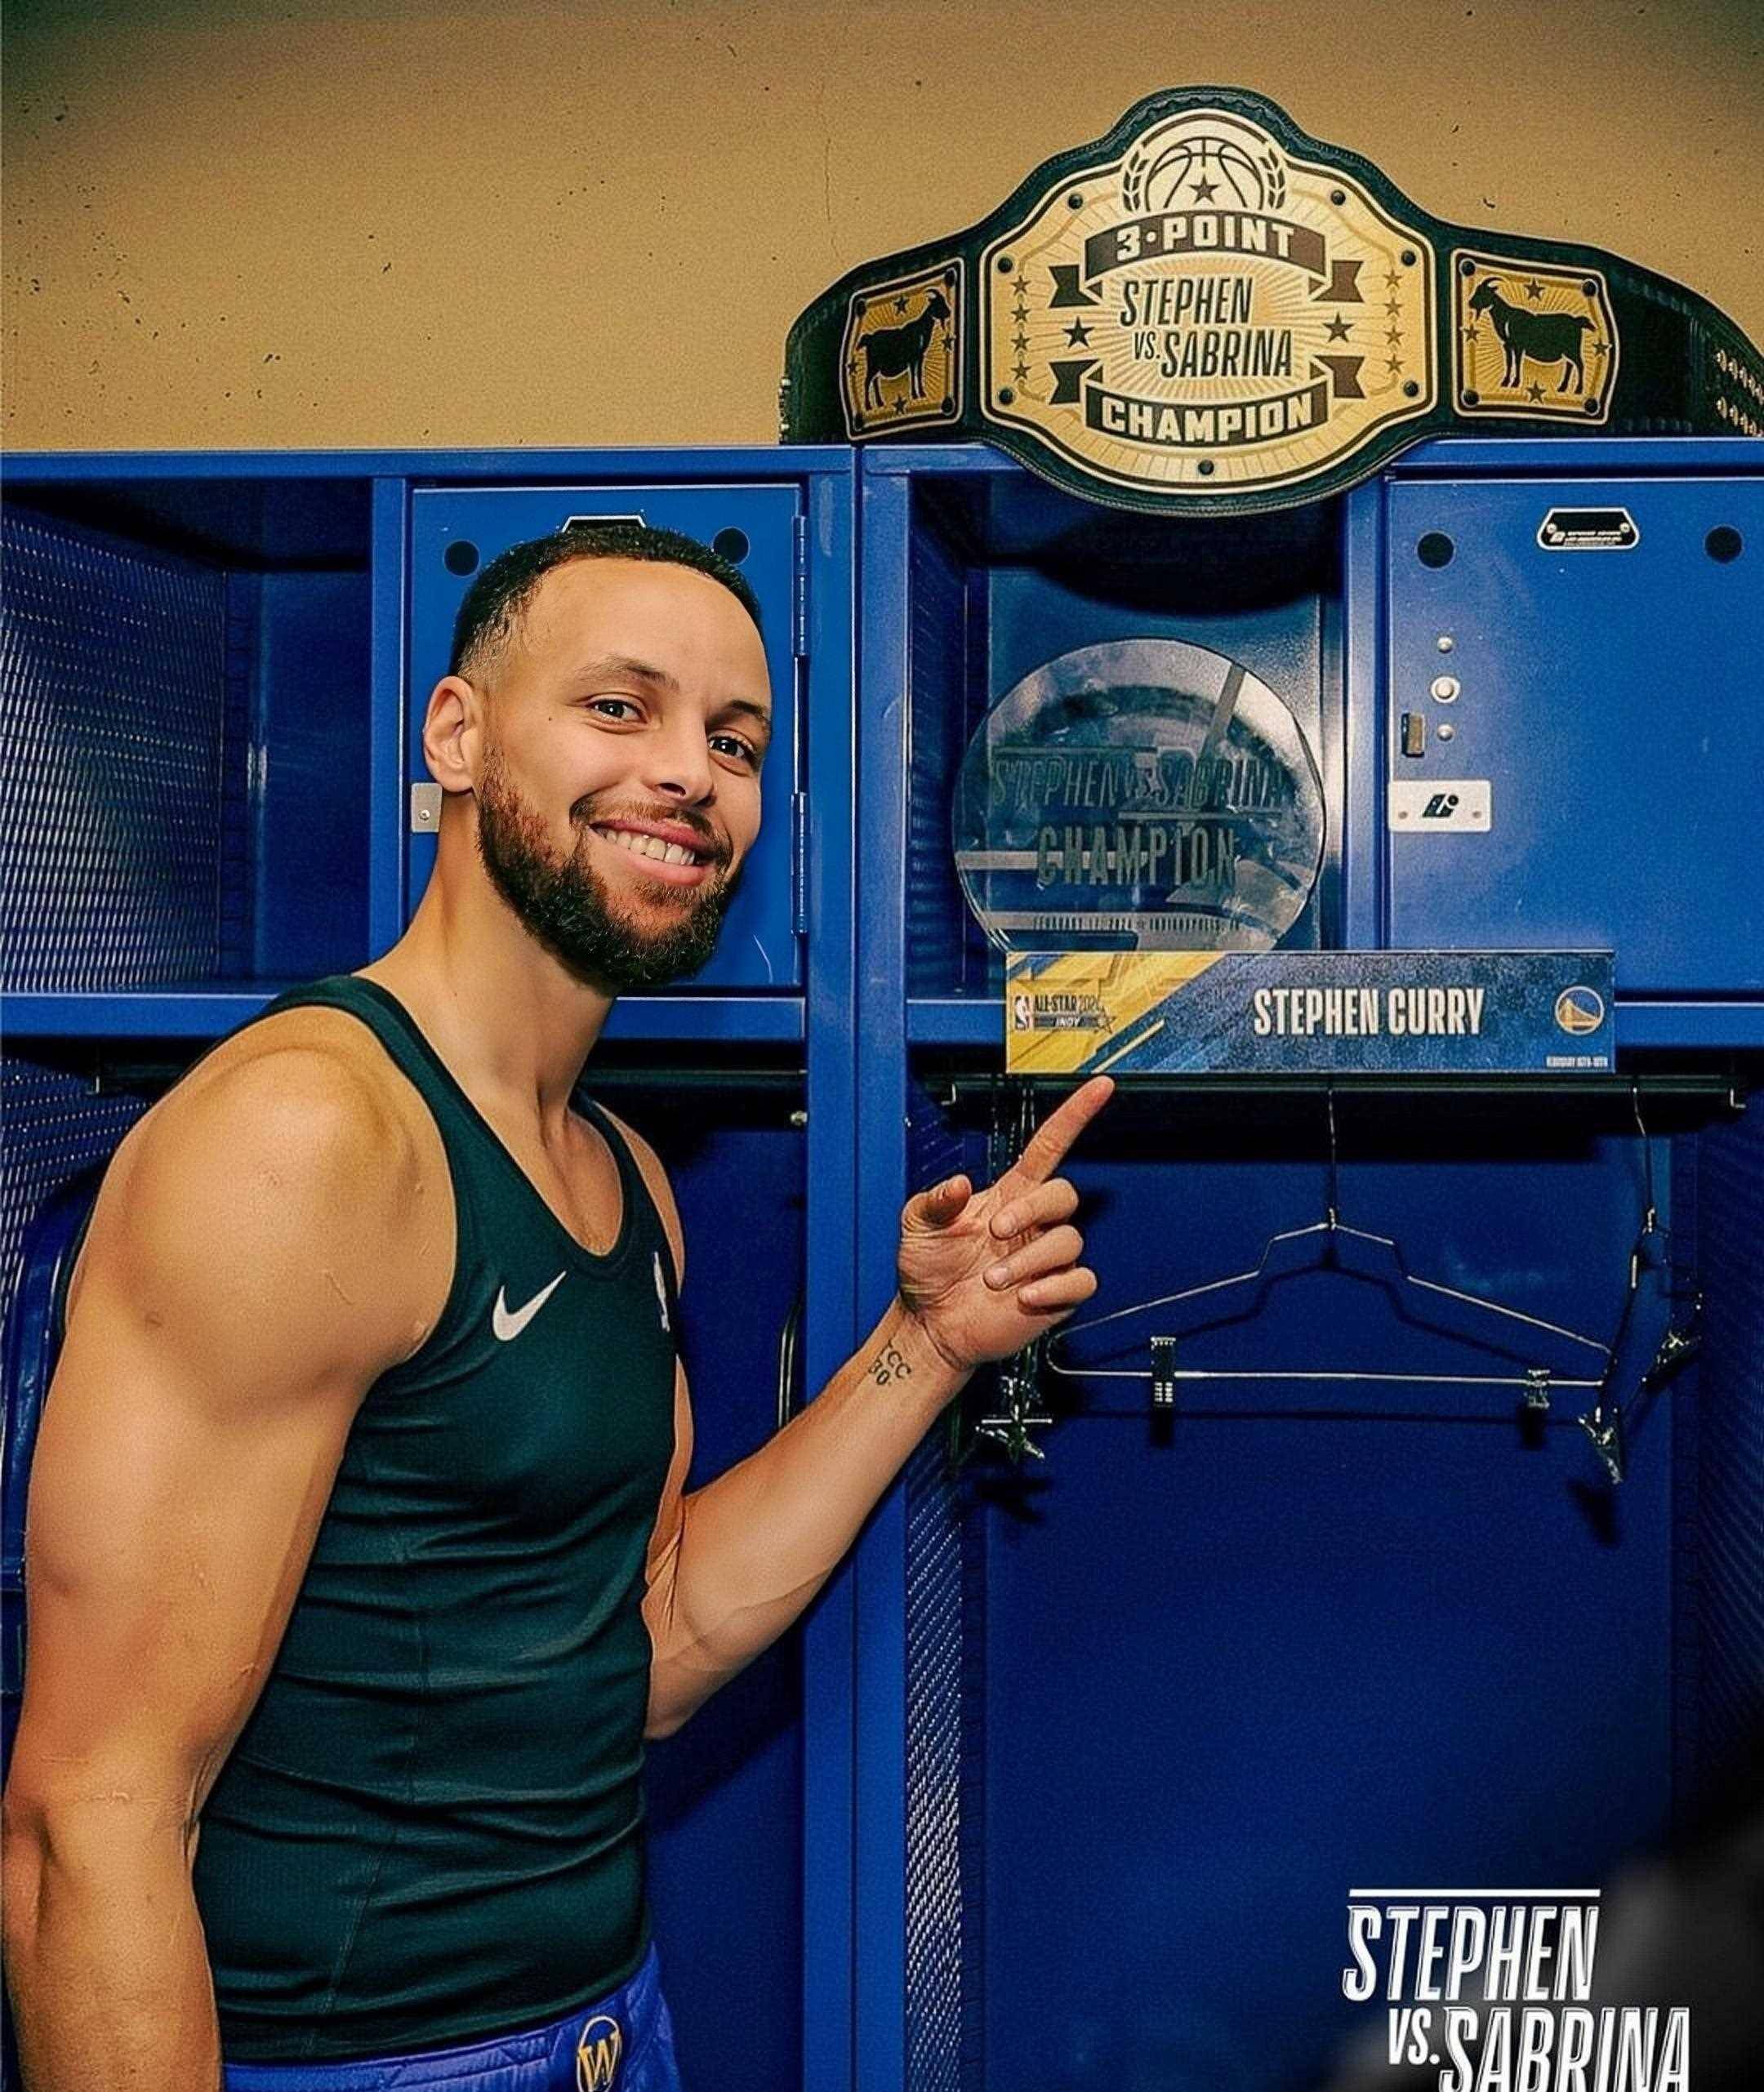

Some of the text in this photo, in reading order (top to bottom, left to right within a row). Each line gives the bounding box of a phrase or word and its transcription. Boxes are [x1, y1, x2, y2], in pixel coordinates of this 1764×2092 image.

[1120, 278, 1253, 327] STEPHEN
[1134, 329, 1293, 379] VS. SABRINA
[1101, 393, 1313, 443] CHAMPION
[991, 757, 1119, 808] STEPHEN
[1036, 825, 1236, 887] CHAMPION
[1254, 988, 1484, 1035] STEPHEN CURRY
